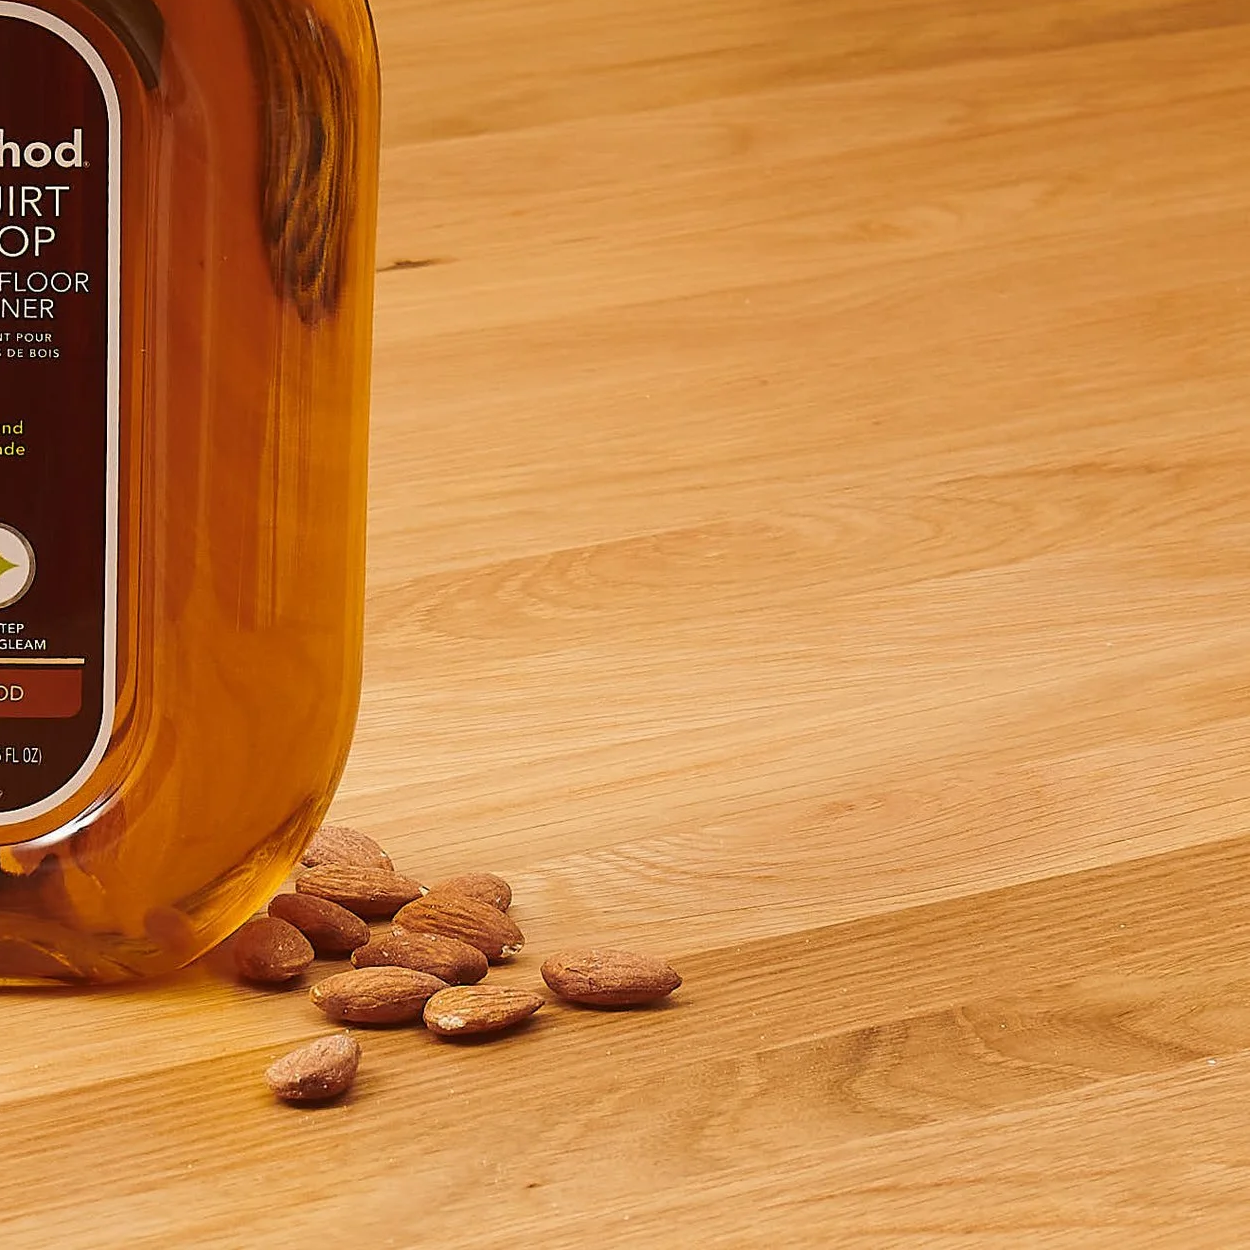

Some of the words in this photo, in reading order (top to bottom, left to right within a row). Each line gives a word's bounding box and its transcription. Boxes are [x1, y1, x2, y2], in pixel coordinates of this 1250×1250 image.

[16, 332, 52, 343] POUR
[7, 348, 24, 358] DE
[29, 348, 60, 358] BOIS
[5, 747, 20, 764] FL
[23, 747, 43, 766] OZ)
